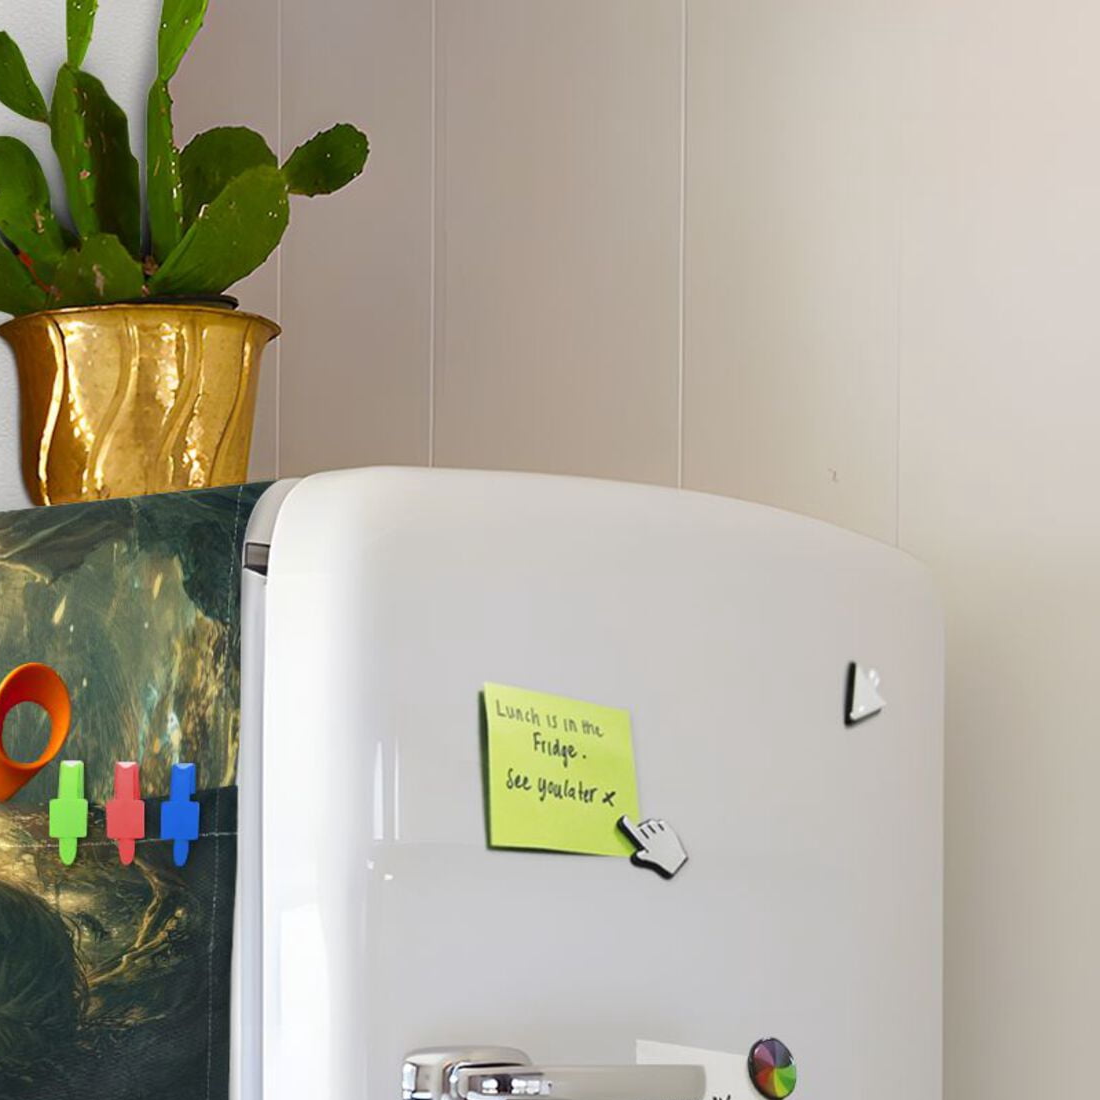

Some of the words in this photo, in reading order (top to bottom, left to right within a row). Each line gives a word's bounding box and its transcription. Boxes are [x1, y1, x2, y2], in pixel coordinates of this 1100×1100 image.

[496, 699, 540, 727] Lunch
[563, 718, 577, 733] in
[581, 719, 604, 737] the
[506, 767, 531, 790] See
